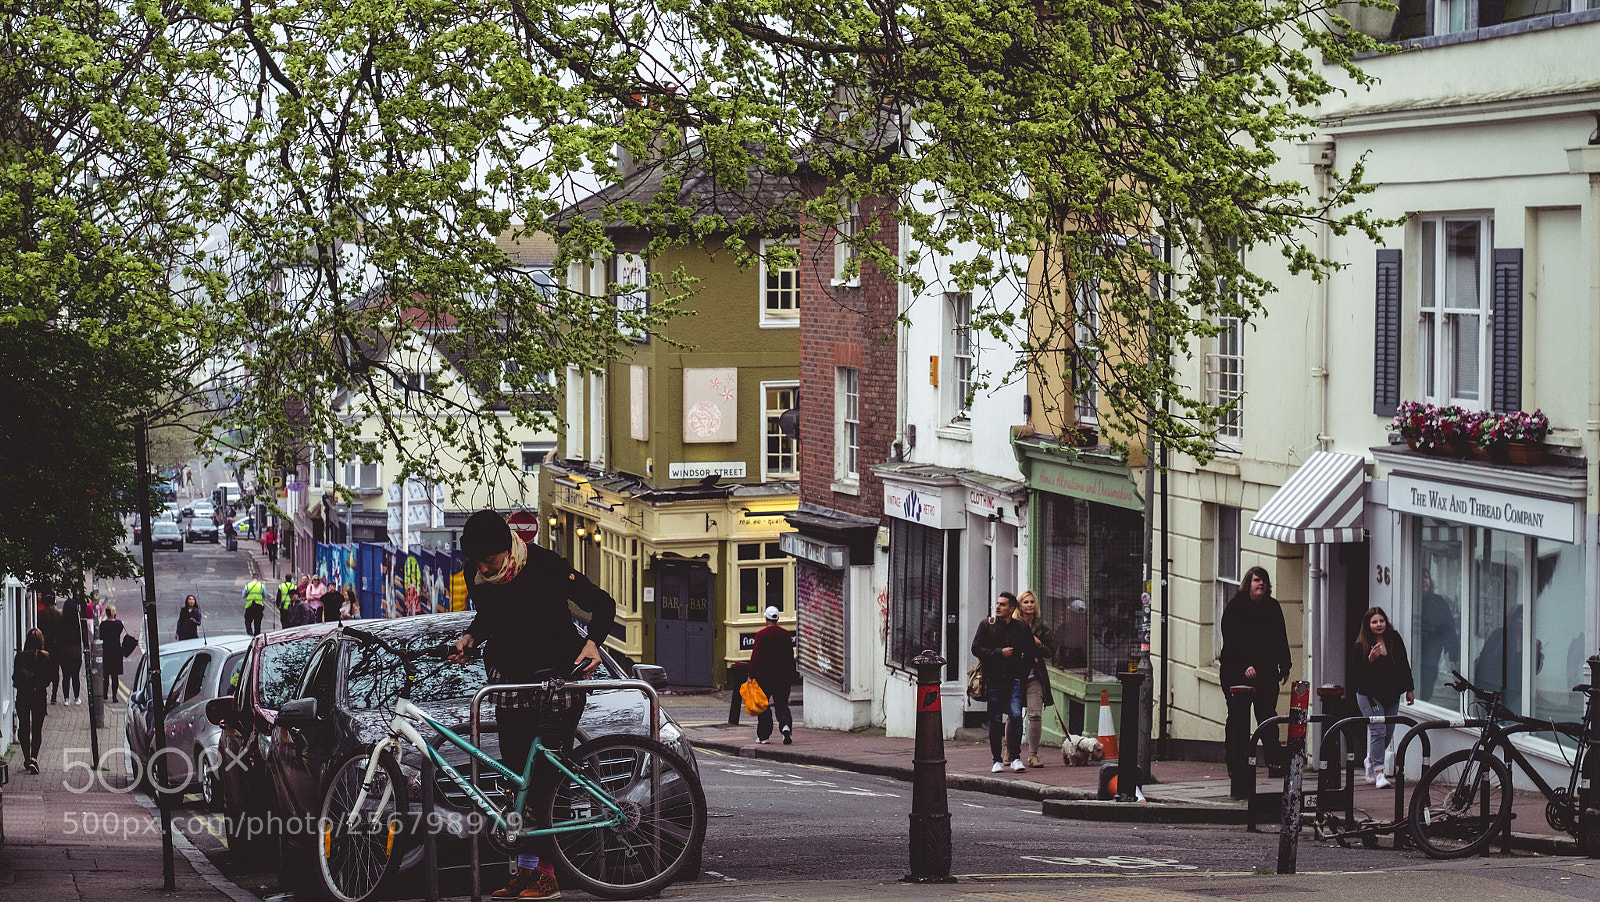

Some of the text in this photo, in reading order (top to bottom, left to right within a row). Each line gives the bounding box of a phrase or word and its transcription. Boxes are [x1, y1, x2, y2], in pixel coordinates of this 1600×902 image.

[672, 468, 743, 477] WINDSOR STREET
[886, 494, 902, 508] VINTAGE
[923, 503, 936, 517] RETRO
[970, 491, 995, 509] CLOTHING
[1376, 564, 1391, 585] 36
[662, 596, 707, 610] BAR BAR
[441, 765, 497, 816] GIANT
